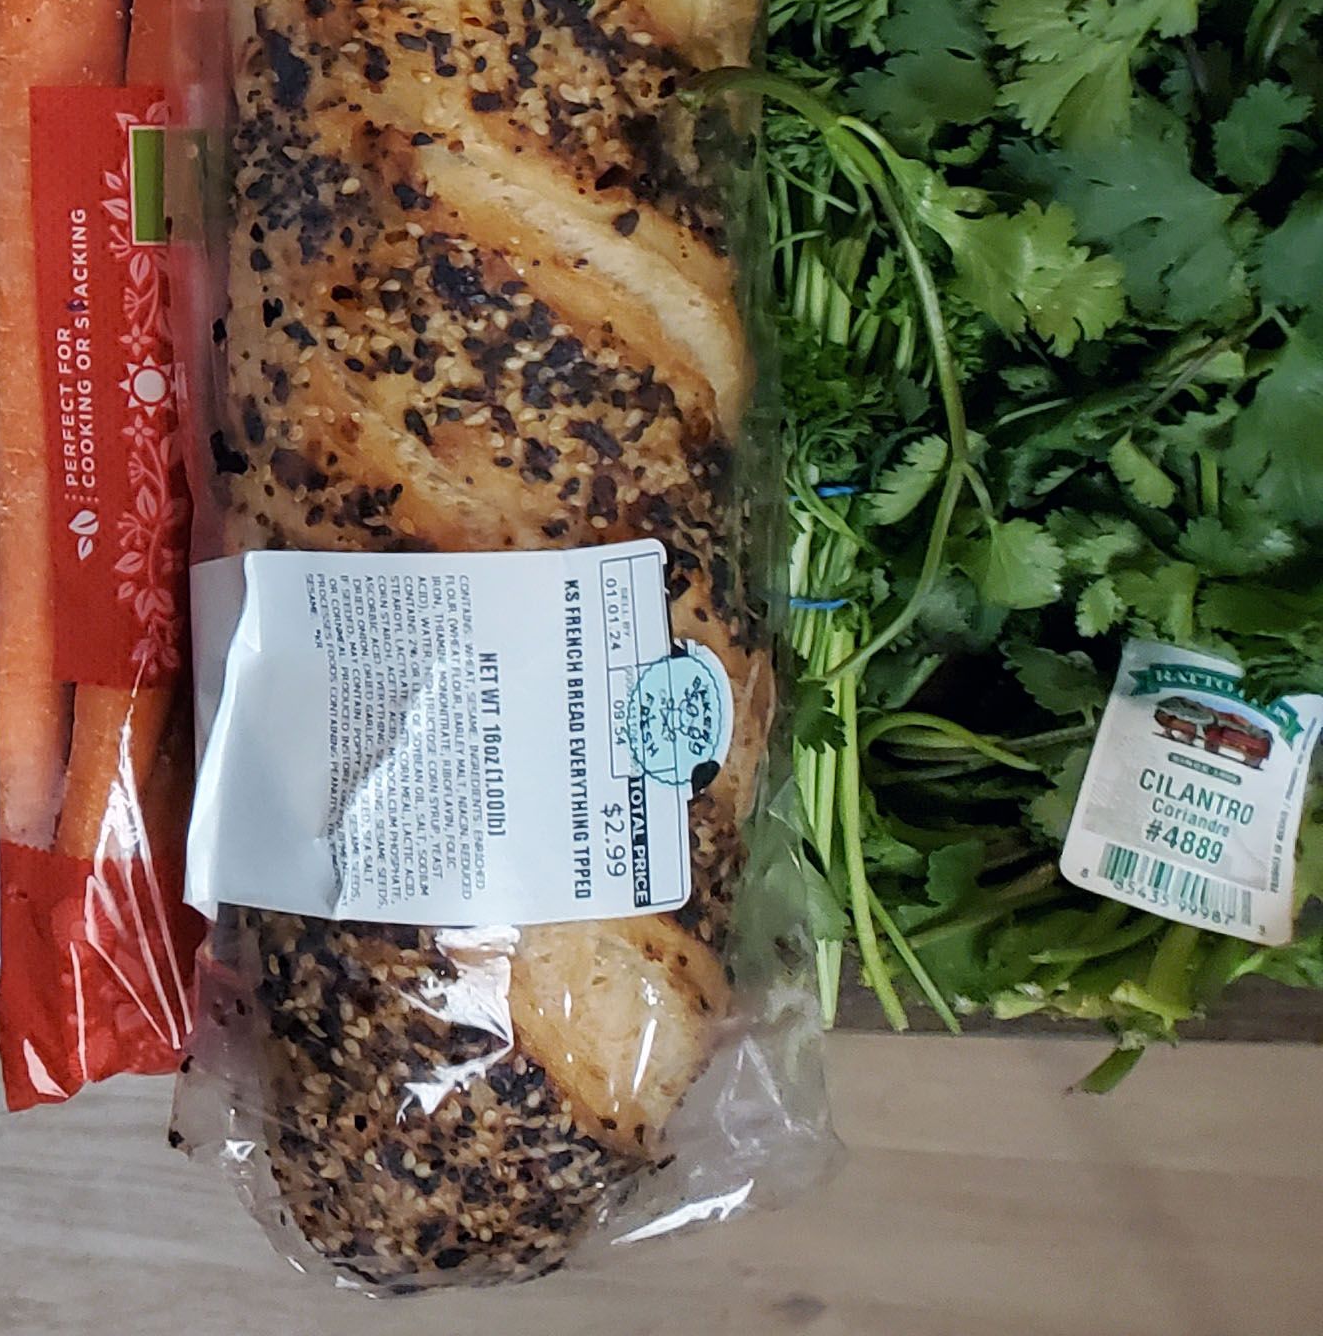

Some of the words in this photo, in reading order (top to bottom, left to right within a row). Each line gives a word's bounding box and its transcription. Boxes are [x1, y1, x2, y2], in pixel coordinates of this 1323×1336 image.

[56, 327, 73, 374] FOR
[74, 338, 92, 370] OR
[58, 382, 78, 487] PERFECT
[75, 377, 96, 489] COOKING
[563, 578, 580, 603] KS
[564, 606, 585, 671] FRENCH
[478, 651, 498, 686] NET
[480, 688, 501, 716] WT
[566, 676, 585, 734] BREAD
[481, 723, 504, 768] 16oz
[568, 737, 591, 842] EVERYTHING
[628, 776, 646, 841] TOTAL
[1138, 767, 1255, 826] CILANTRO
[600, 801, 628, 878] $2.99
[1144, 817, 1224, 866] #4889
[1151, 796, 1231, 838] Coriandre
[431, 841, 444, 880] YEAST
[573, 846, 592, 900] TPPED
[632, 844, 651, 906] PRICE
